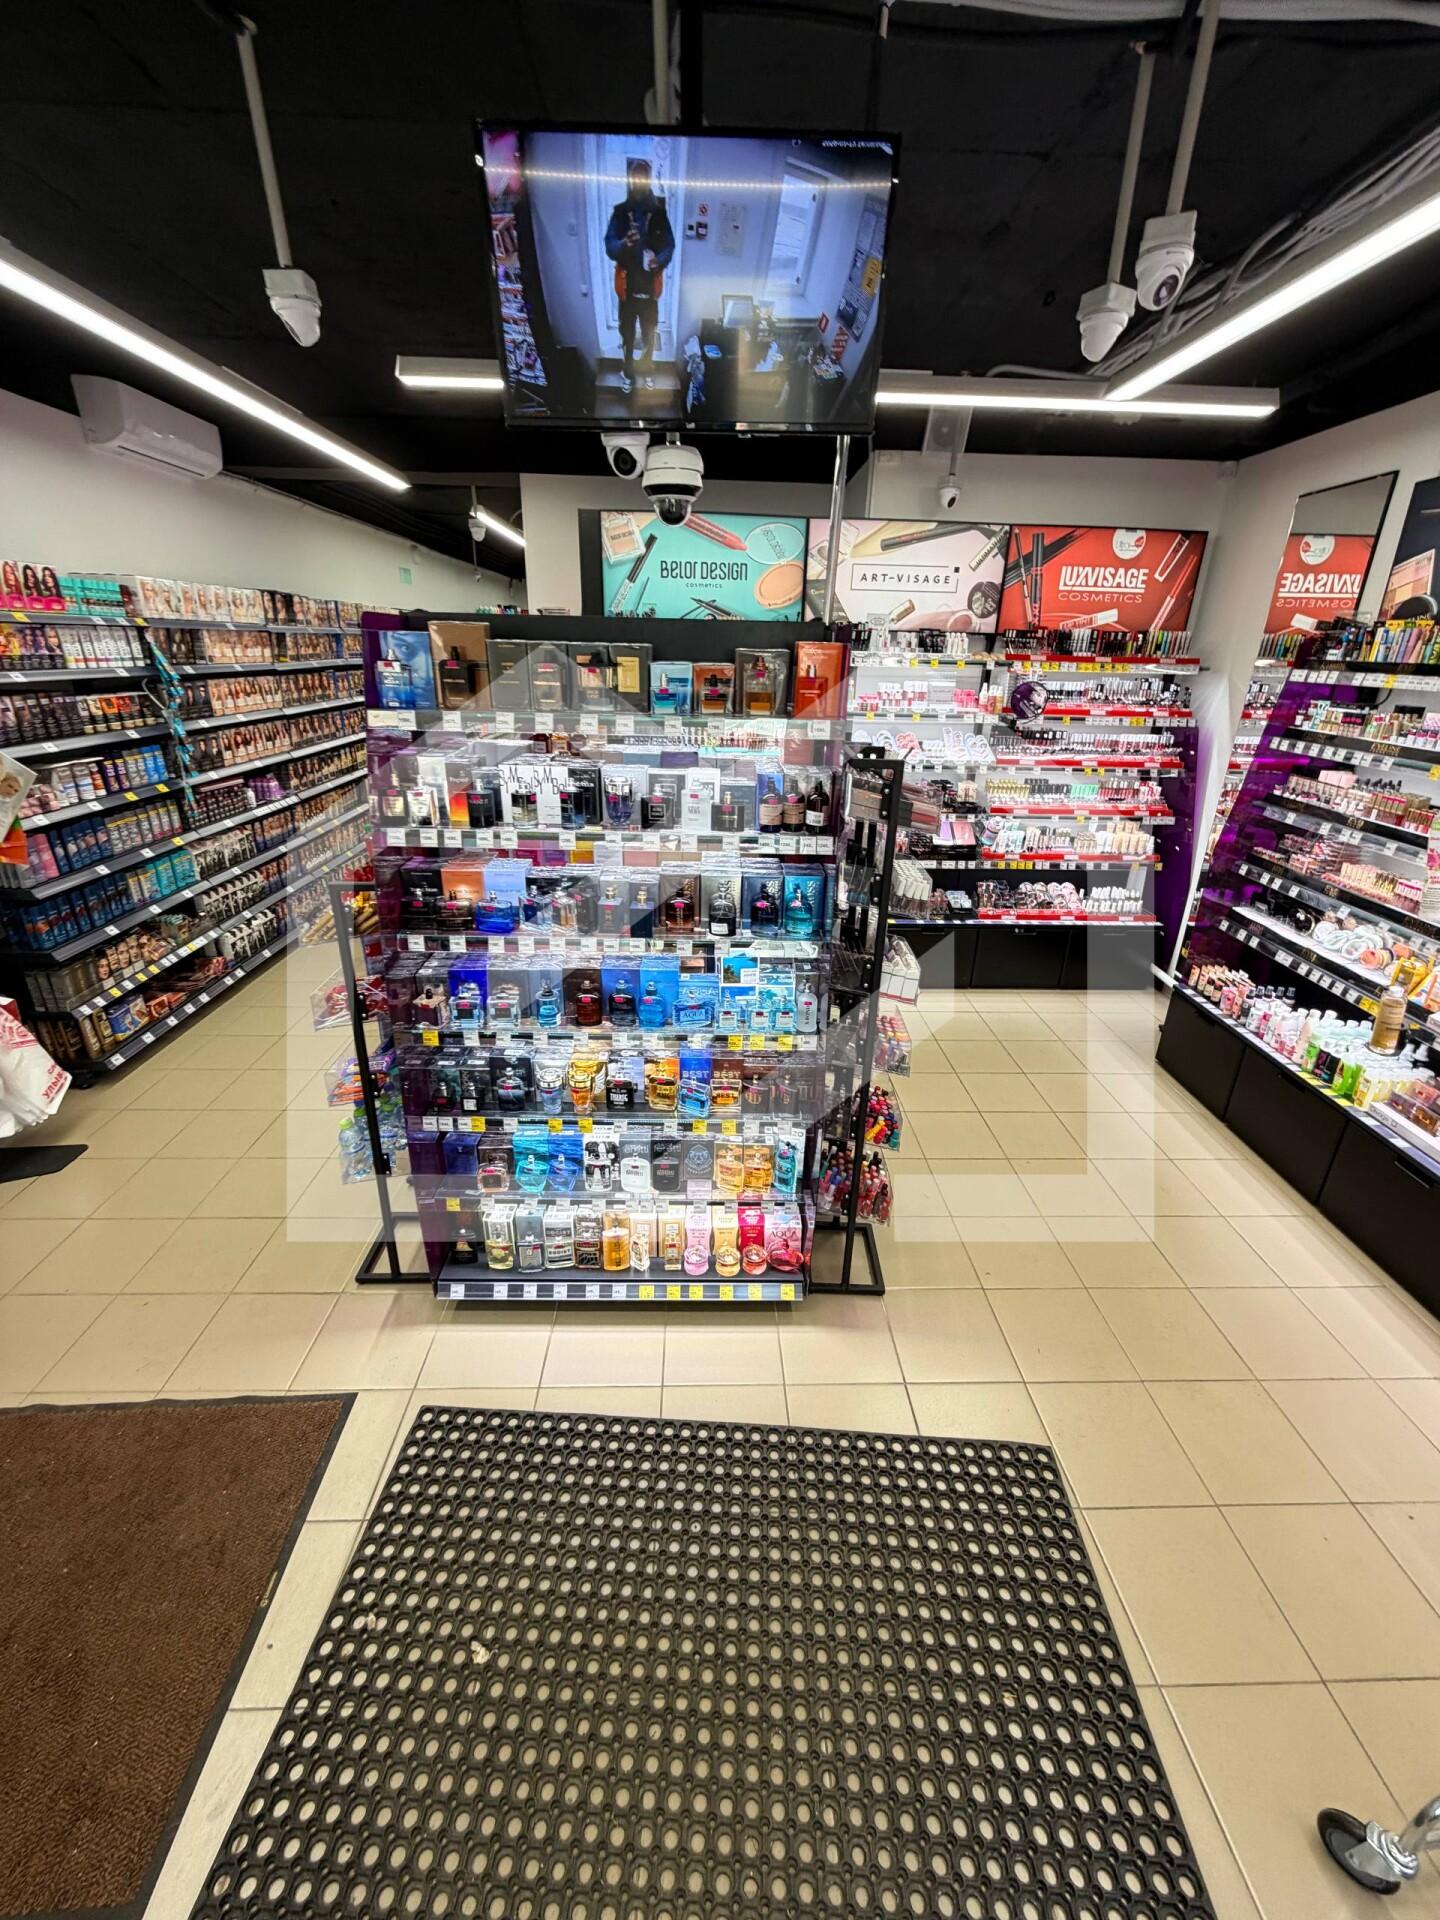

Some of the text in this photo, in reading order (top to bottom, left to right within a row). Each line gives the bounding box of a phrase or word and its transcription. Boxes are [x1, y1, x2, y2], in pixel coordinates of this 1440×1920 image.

[860, 573, 951, 584] ART-VISAGE
[1059, 566, 1149, 591] LUXVISAGE
[1057, 592, 1143, 604] COSMETICS
